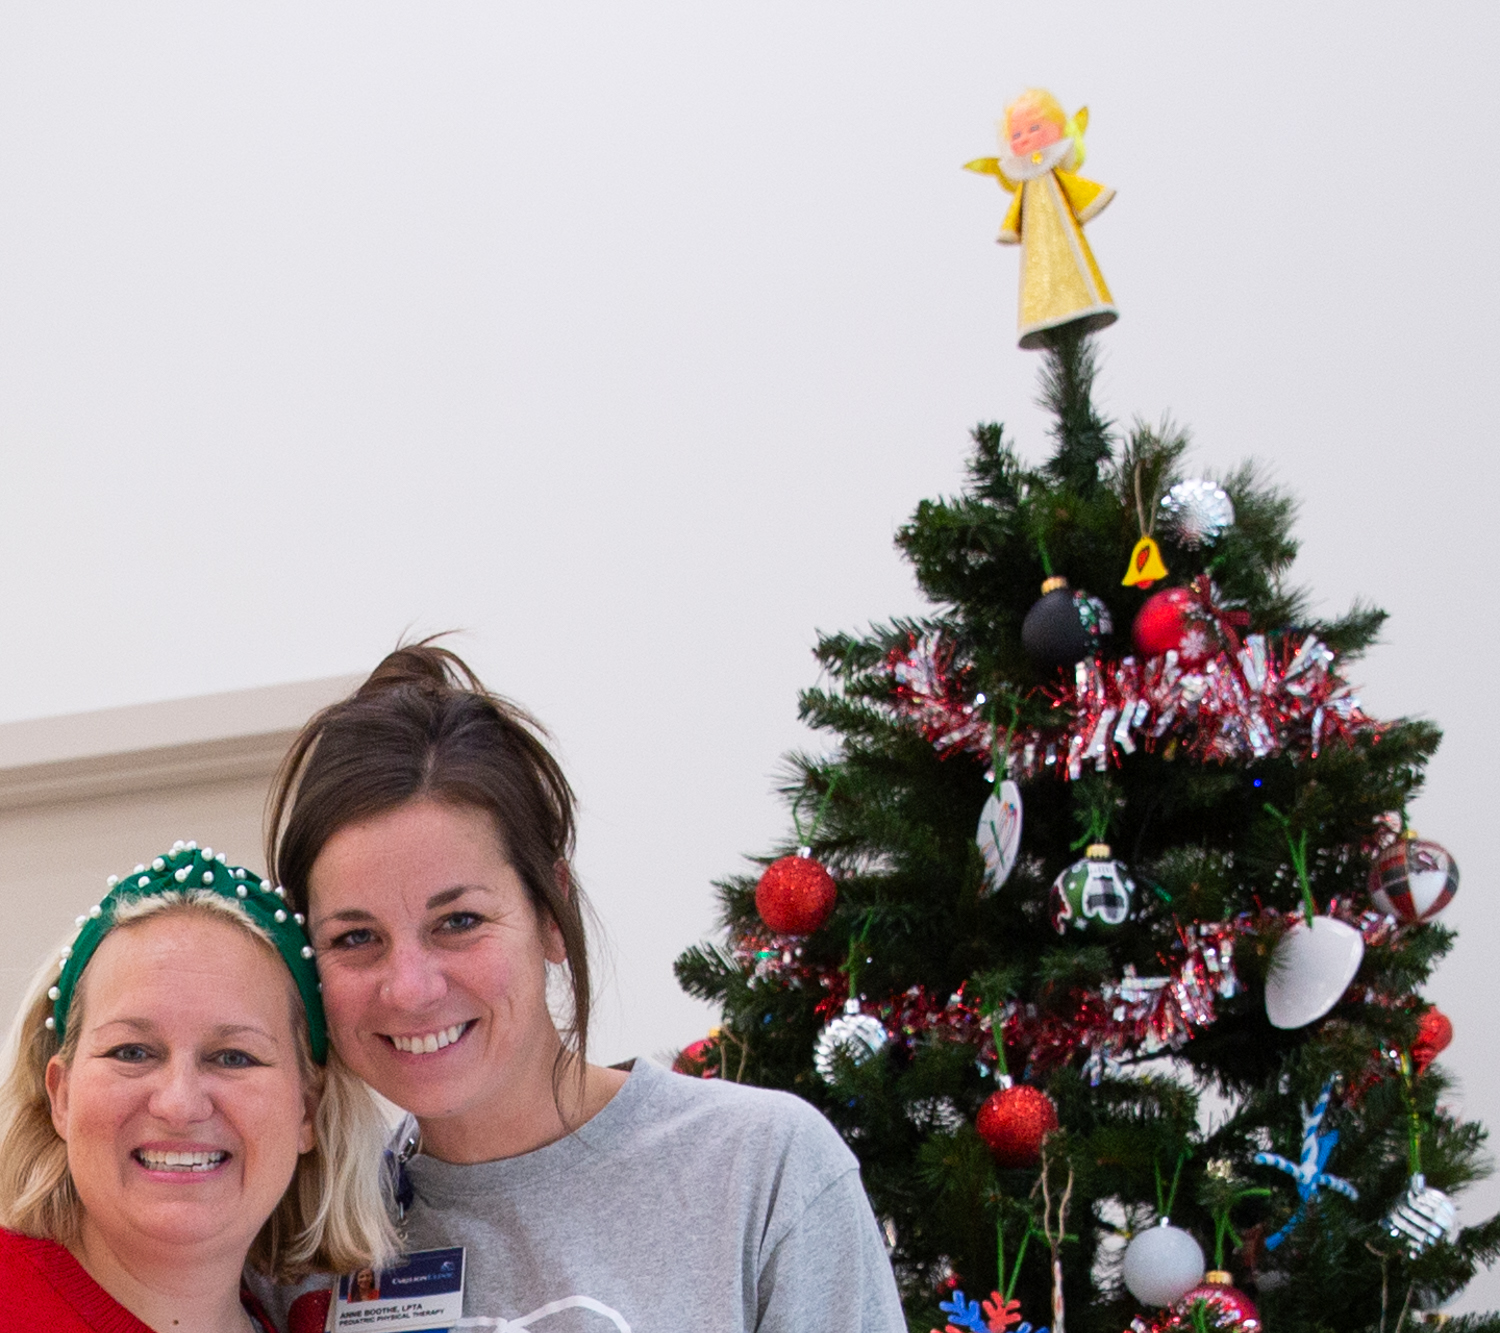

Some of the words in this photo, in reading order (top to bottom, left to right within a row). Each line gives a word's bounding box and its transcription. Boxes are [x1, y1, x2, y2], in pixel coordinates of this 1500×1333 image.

[339, 1310, 362, 1320] ANNE
[402, 1303, 422, 1314] LPTA
[339, 1316, 375, 1326] PEDIATRIC
[376, 1313, 410, 1322] PHYSICAL
[413, 1309, 444, 1319] THERAPY
